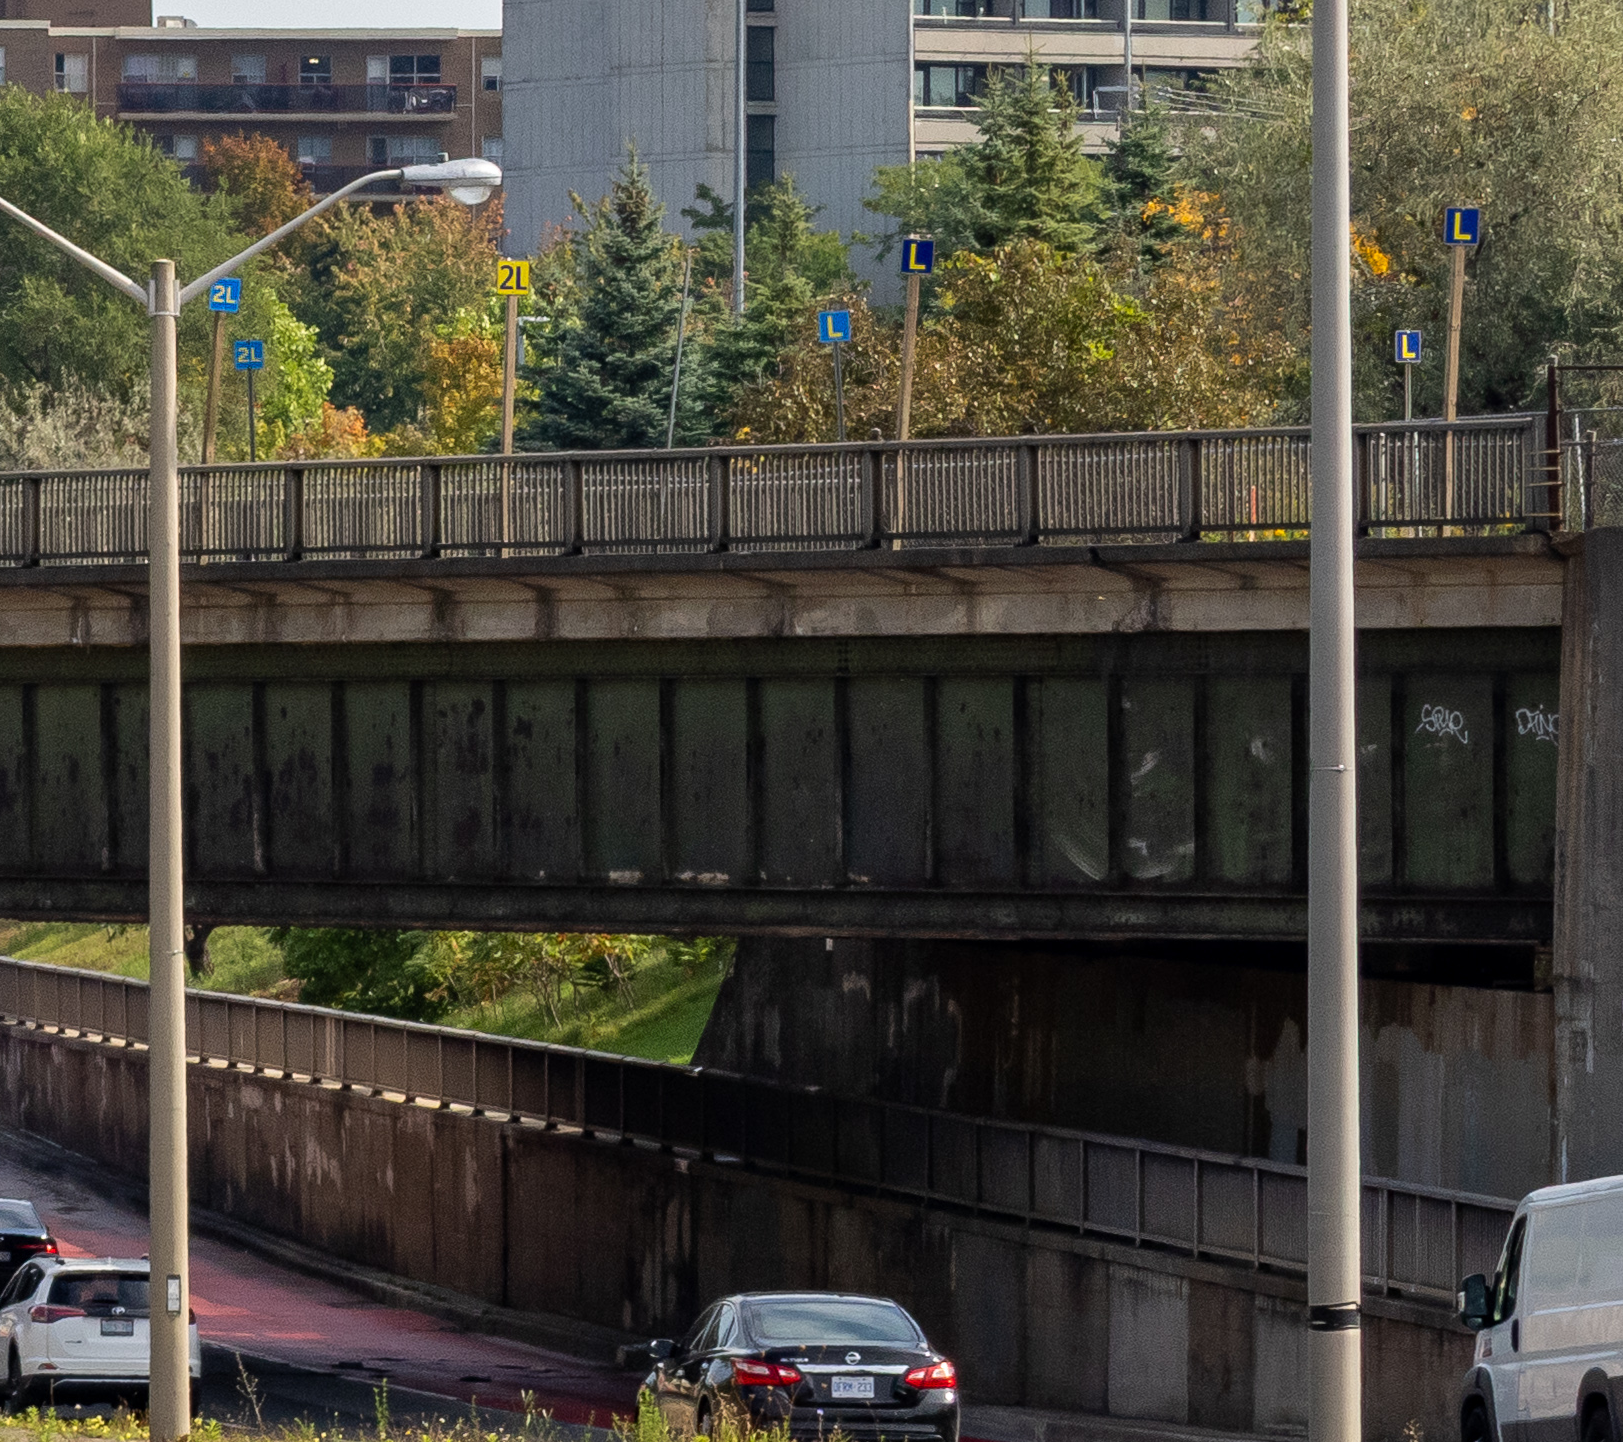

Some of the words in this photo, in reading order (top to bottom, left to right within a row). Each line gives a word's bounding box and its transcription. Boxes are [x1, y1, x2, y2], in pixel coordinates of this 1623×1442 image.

[1454, 212, 1472, 241] L
[909, 243, 926, 269] L
[499, 264, 527, 291] 2L
[212, 284, 237, 305] 2L
[827, 315, 844, 338] L
[237, 347, 262, 363] 2L
[1401, 334, 1416, 359] L
